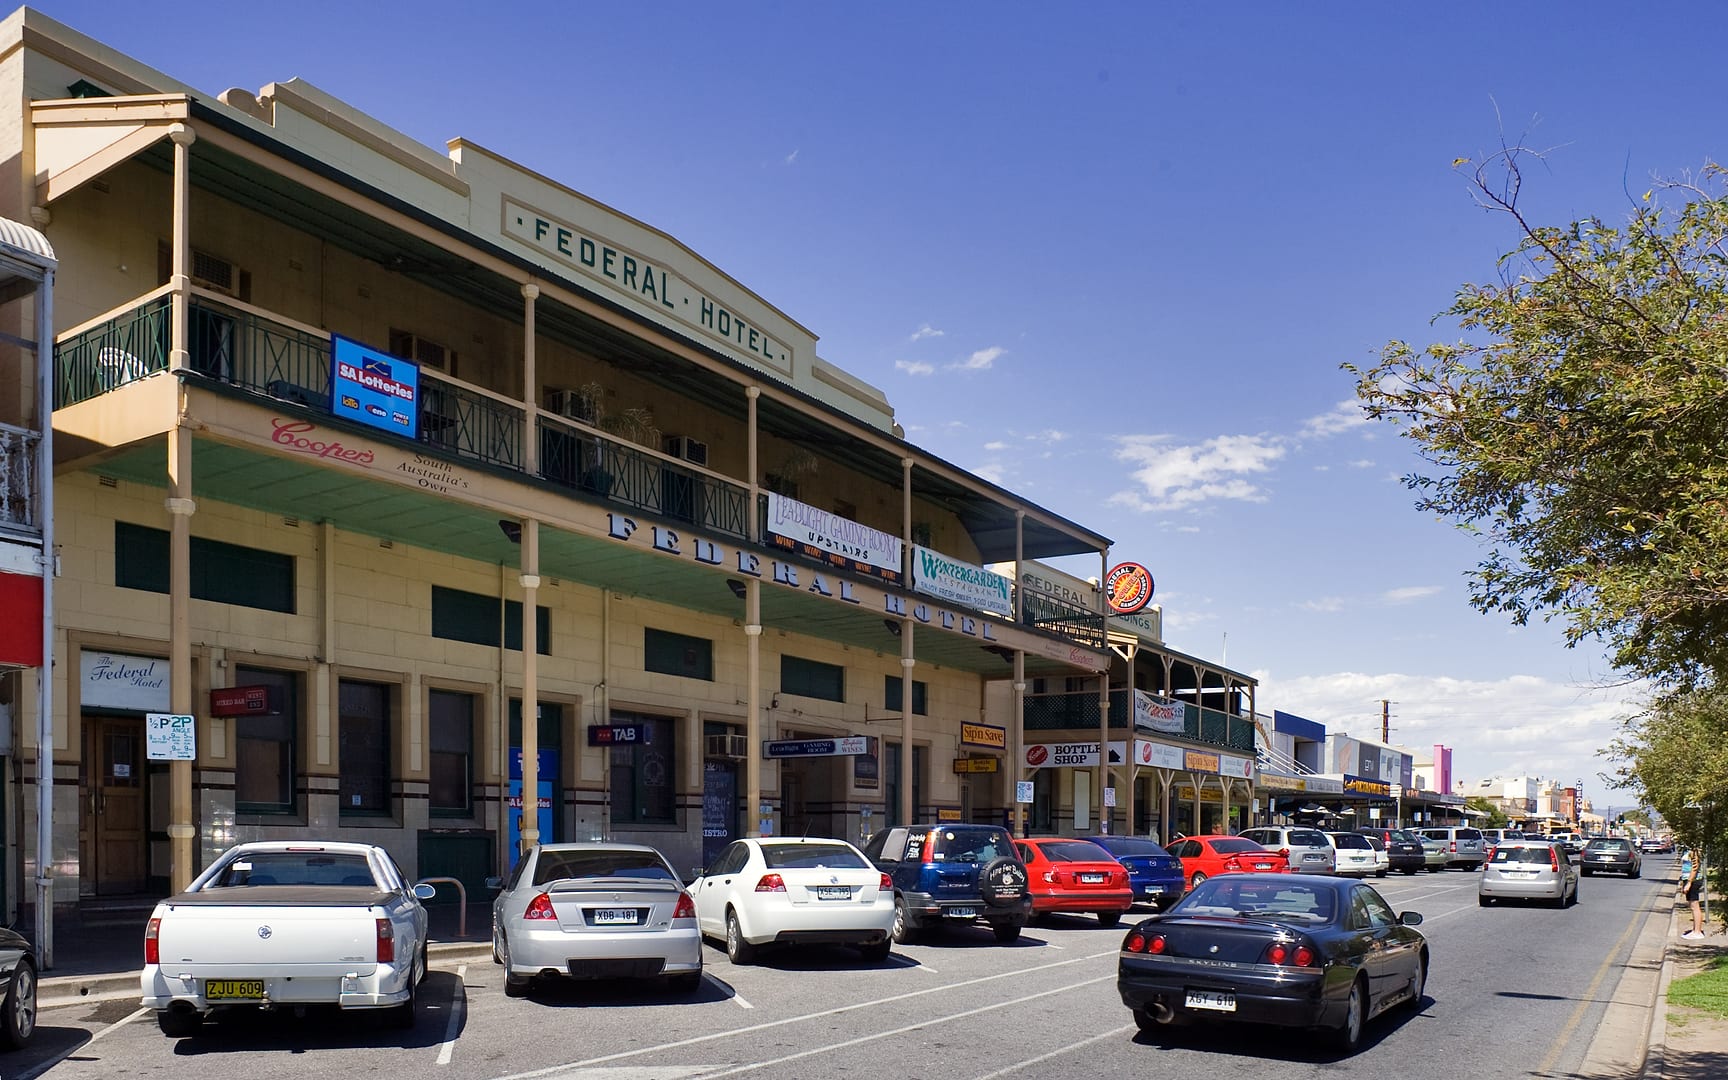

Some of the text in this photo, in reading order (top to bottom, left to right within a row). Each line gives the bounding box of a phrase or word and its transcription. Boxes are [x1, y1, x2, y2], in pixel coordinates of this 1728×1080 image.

[535, 218, 773, 360] FEDERAL HOTEL
[340, 364, 413, 400] SA Lotteries
[413, 454, 452, 473] South
[396, 461, 470, 489] Australia's
[418, 478, 448, 494] Own
[808, 531, 869, 560] UPSTAIRS
[775, 534, 896, 580] WIN! WIN! WIN! WIN! WIN!
[606, 512, 998, 641] FEDERAL HOTEL
[1107, 567, 1130, 595] FEDERAL
[938, 575, 997, 597] RESTAURANT
[1023, 573, 1087, 605] FEDERAL
[97, 656, 115, 666] The
[90, 662, 156, 681] Federal
[130, 677, 163, 688] Hotel
[171, 716, 192, 728] 2P
[612, 727, 636, 741] TAB
[984, 728, 1003, 742] Save
[1054, 754, 1087, 765] SHOP
[597, 911, 636, 921] XDB 187
[1188, 959, 1238, 968] SKYLINE
[208, 982, 262, 995] ZJU 609
[1188, 992, 1234, 1007] XGY 610
